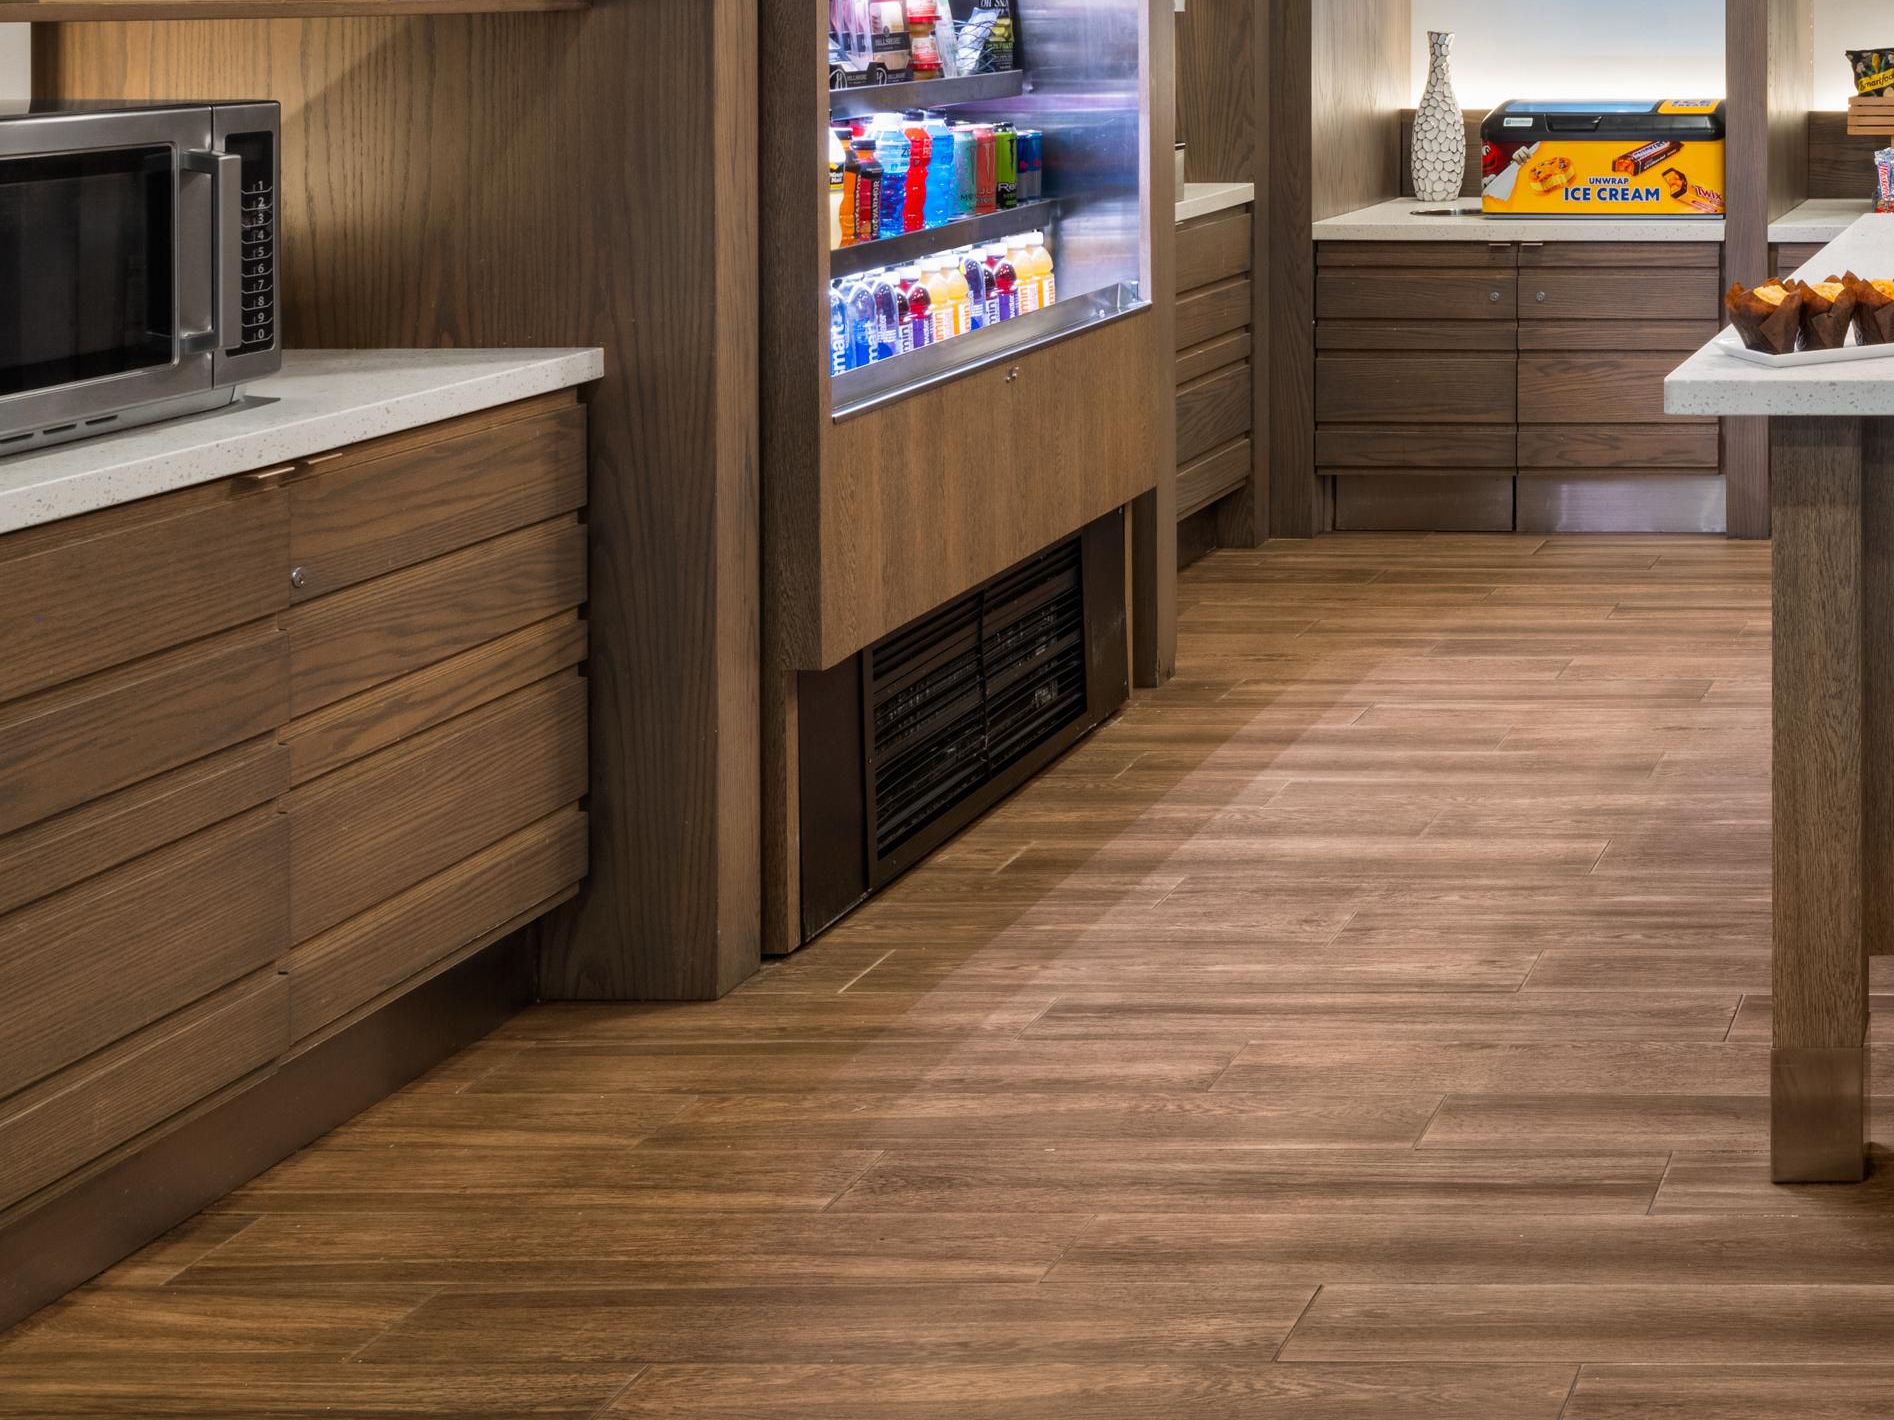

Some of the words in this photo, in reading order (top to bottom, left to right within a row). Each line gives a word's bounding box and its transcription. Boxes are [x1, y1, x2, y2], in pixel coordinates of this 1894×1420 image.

[258, 180, 264, 190] 1
[1564, 187, 1591, 201] ICE
[1597, 187, 1660, 201] CREAM
[258, 197, 264, 207] 2
[258, 213, 264, 223] 3
[258, 230, 264, 240] 4
[258, 246, 264, 257] 5
[258, 263, 264, 273] 6
[258, 280, 264, 290] 7
[258, 296, 264, 306] 8
[258, 312, 264, 322] 9
[258, 329, 264, 339] 0
